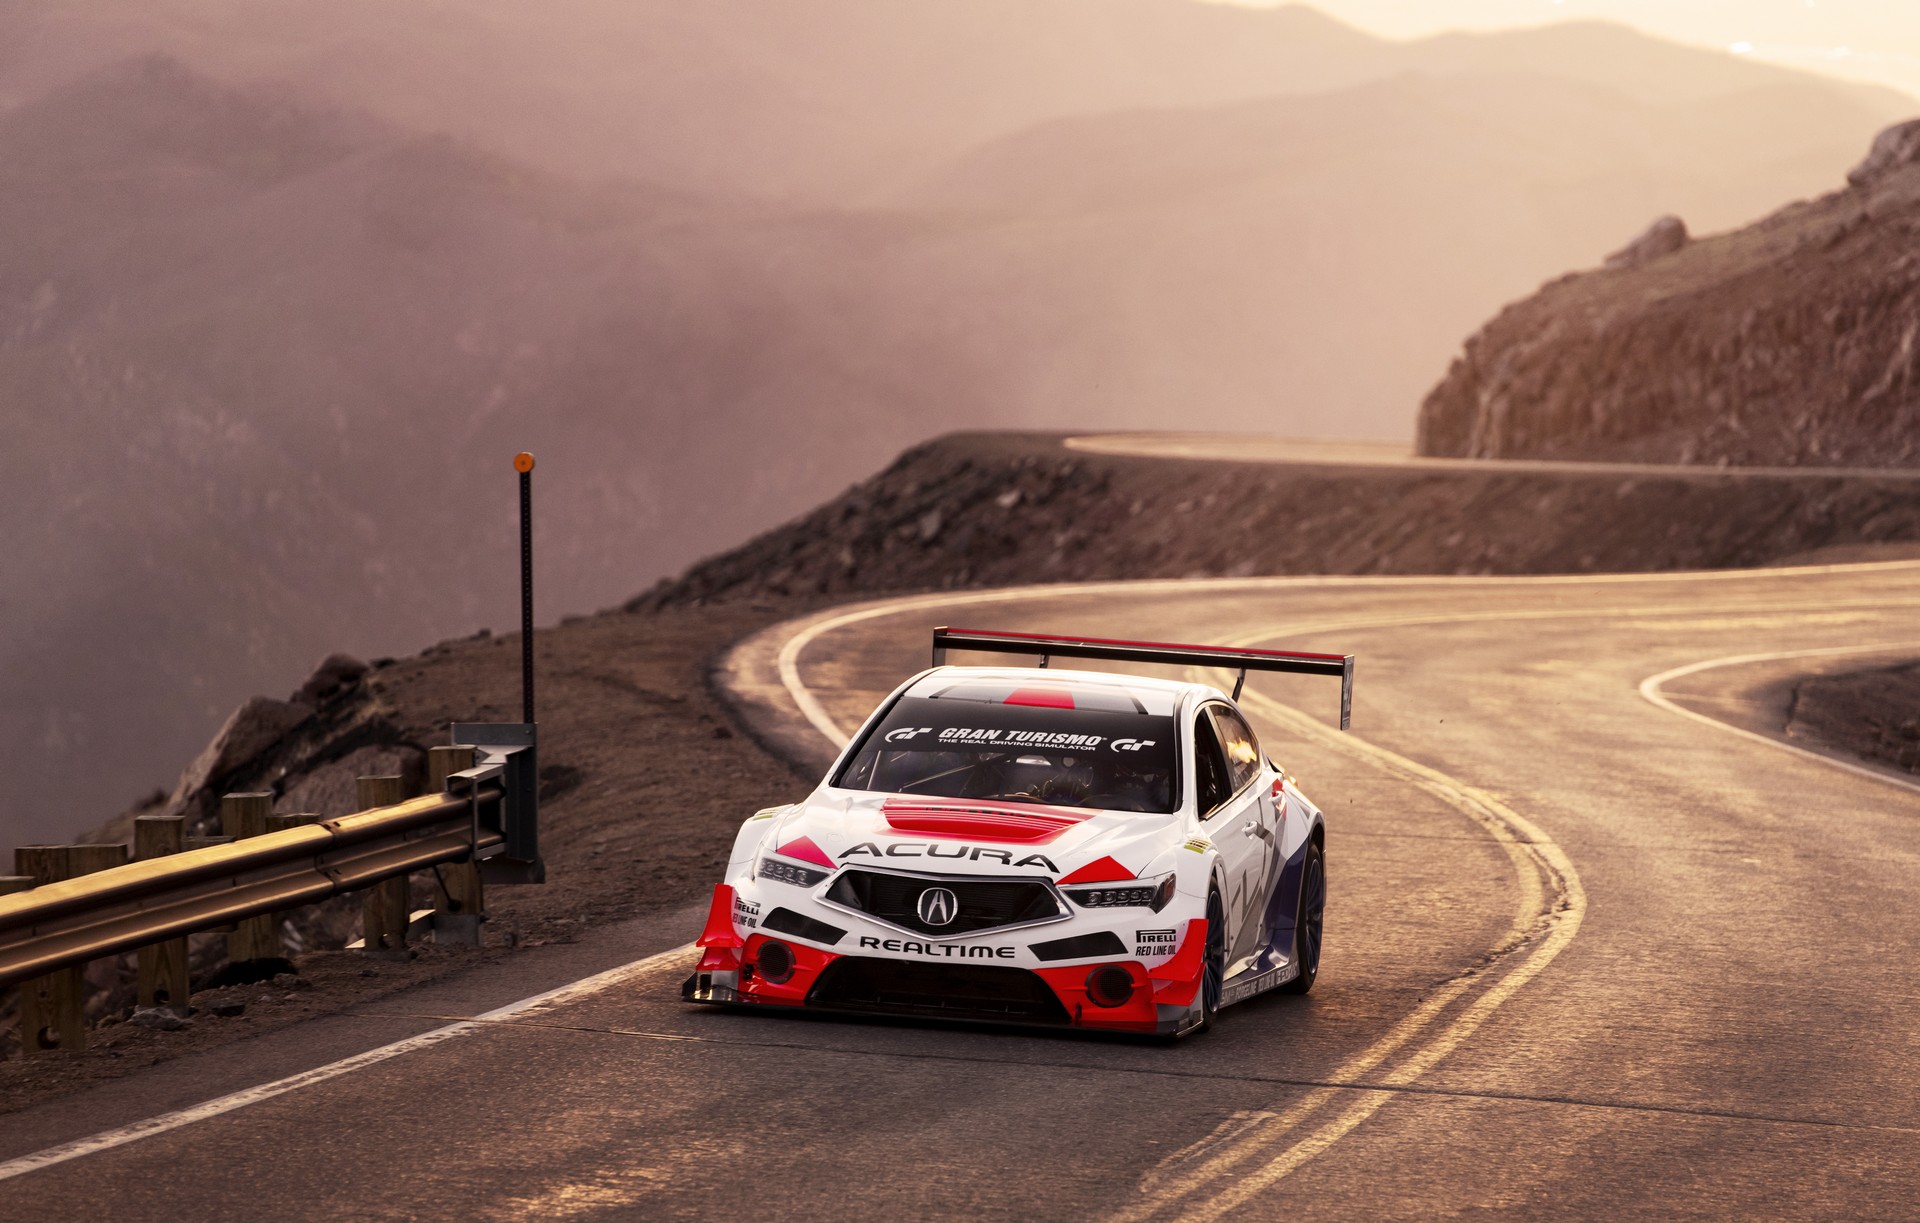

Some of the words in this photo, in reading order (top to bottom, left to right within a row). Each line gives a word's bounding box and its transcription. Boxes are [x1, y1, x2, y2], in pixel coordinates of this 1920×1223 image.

[938, 727, 1003, 740] GRAN
[1004, 730, 1102, 746] TURISMO
[1034, 742, 1096, 751] SIMULATOR
[837, 842, 1061, 874] ACURA
[1135, 929, 1177, 943] PIRELLI
[859, 936, 1016, 959] REALTIME
[1135, 945, 1152, 956] RED
[1152, 945, 1167, 956] LINE
[1167, 944, 1176, 956] OIL
